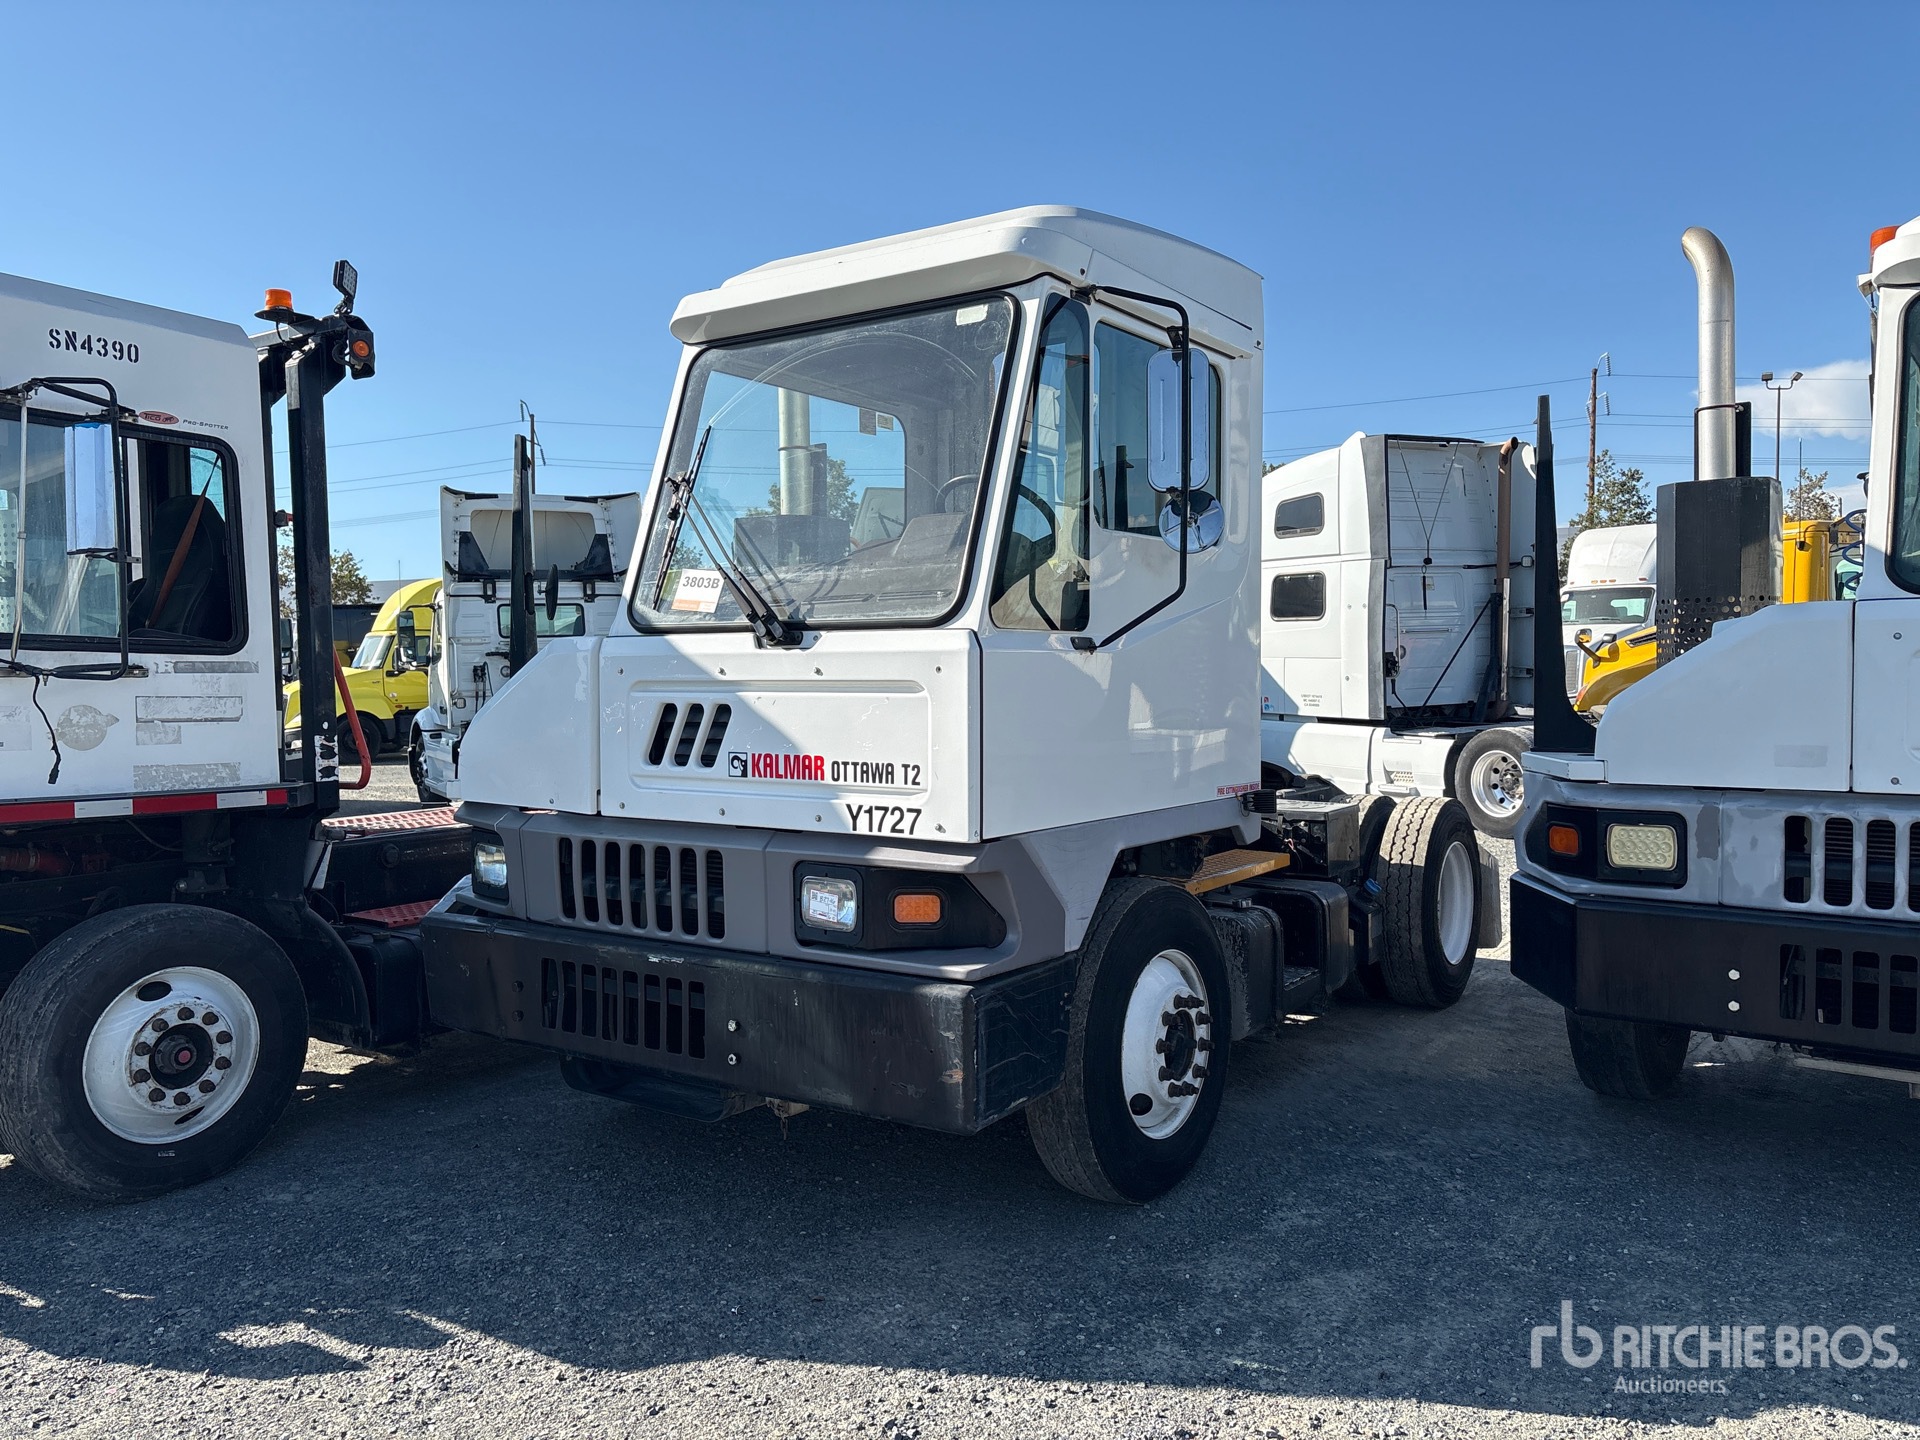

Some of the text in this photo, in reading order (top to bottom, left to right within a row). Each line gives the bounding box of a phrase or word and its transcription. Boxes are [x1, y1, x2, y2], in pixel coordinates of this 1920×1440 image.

[49, 328, 139, 363] SN4390
[682, 576, 720, 589] 3803B
[751, 753, 921, 786] KALMAR OTTAWA T2
[846, 803, 922, 836] Y1727
